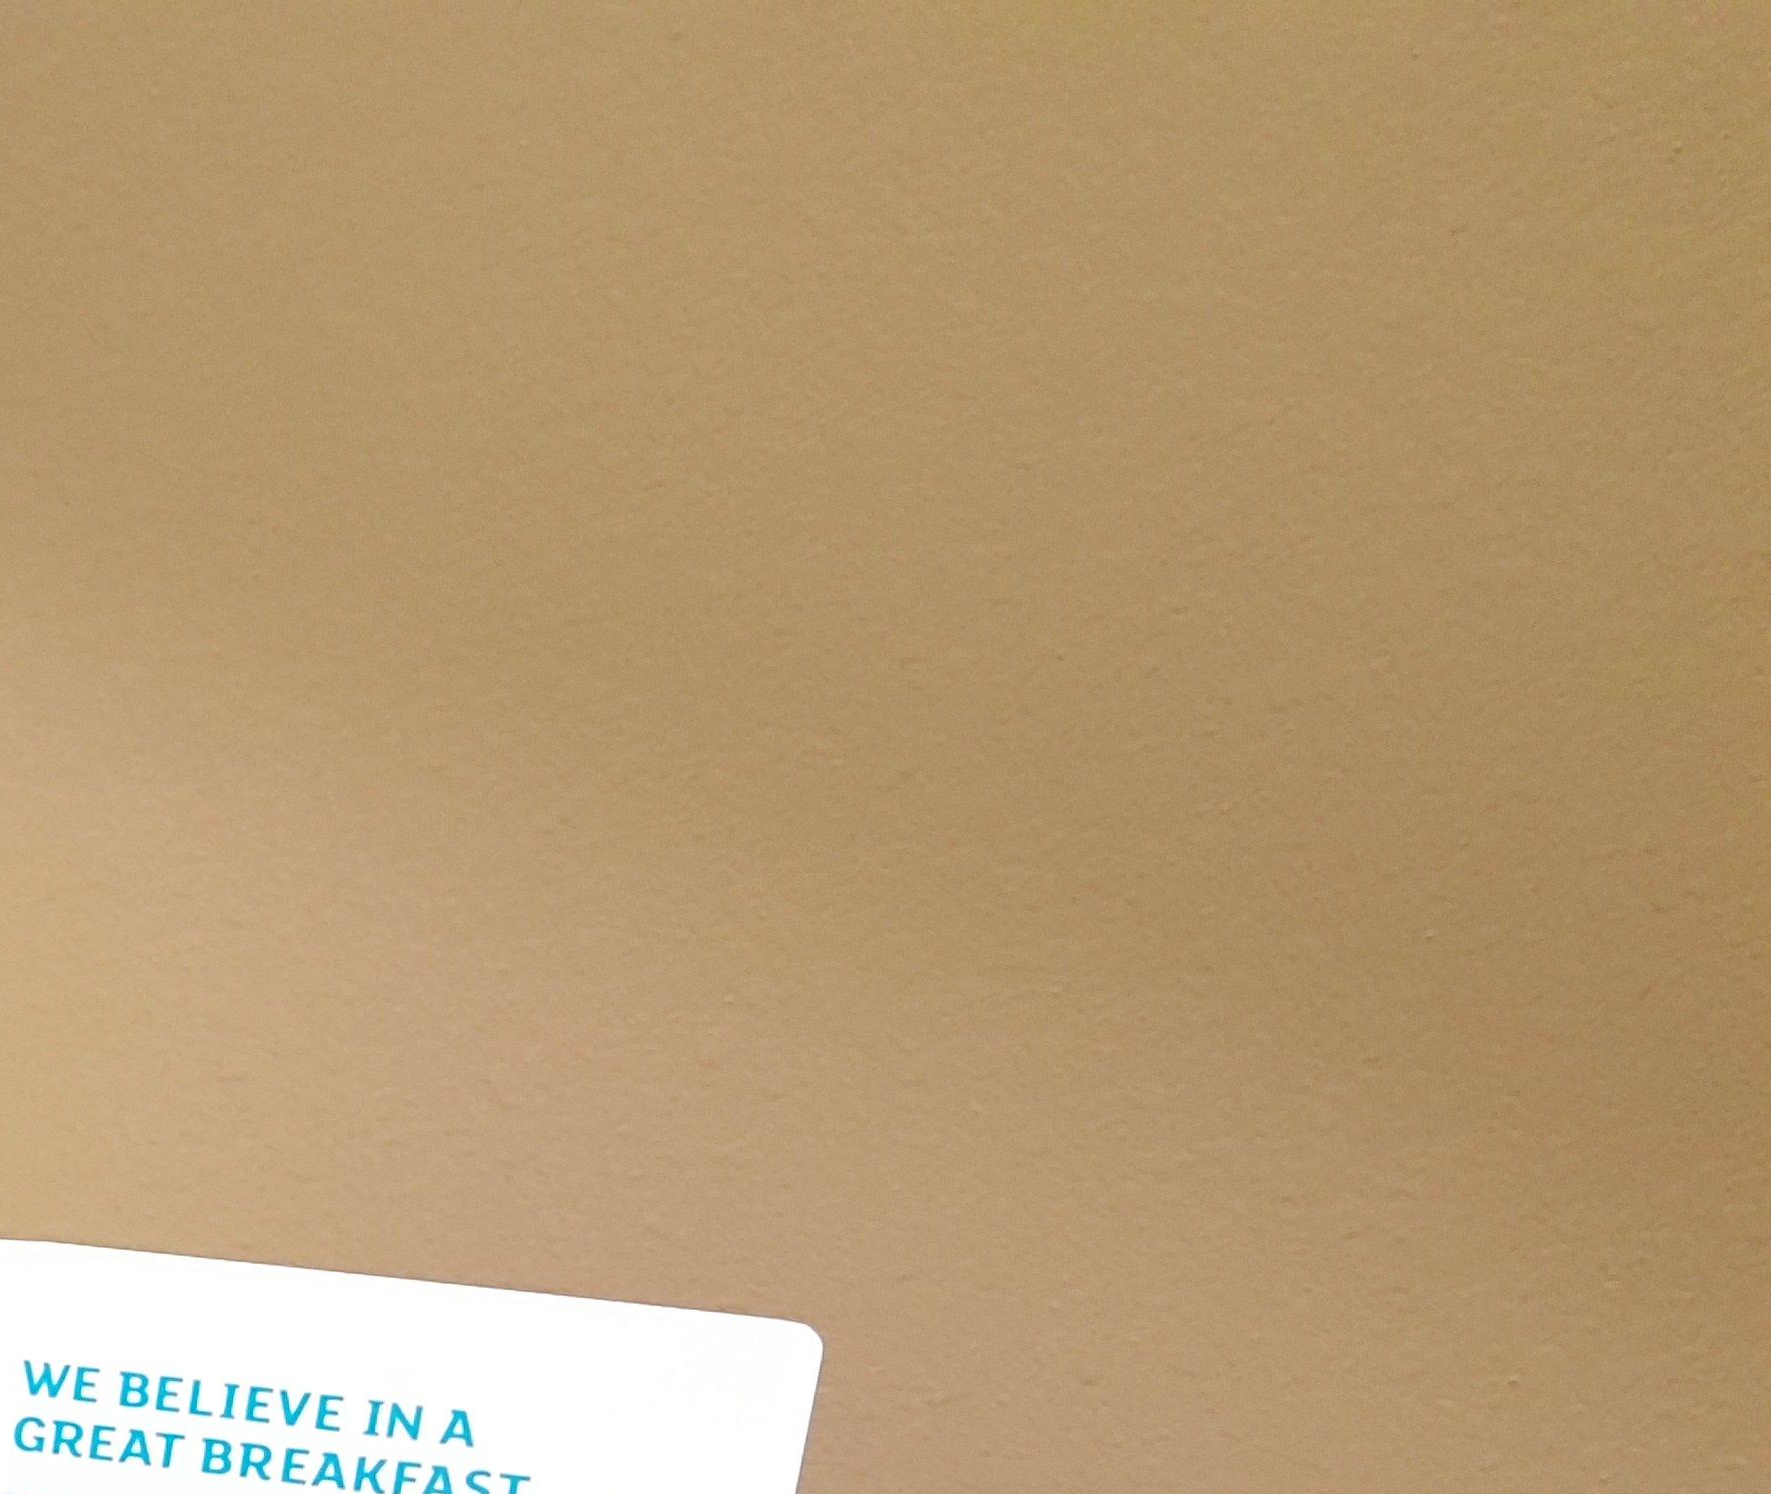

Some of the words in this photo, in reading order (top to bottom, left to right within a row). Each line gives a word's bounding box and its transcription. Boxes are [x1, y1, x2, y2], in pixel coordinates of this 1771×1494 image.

[23, 1360, 100, 1402] WE
[119, 1372, 344, 1433] BELIEVE
[364, 1399, 423, 1441] IN
[440, 1409, 475, 1448] A
[13, 1416, 184, 1469] GREAT
